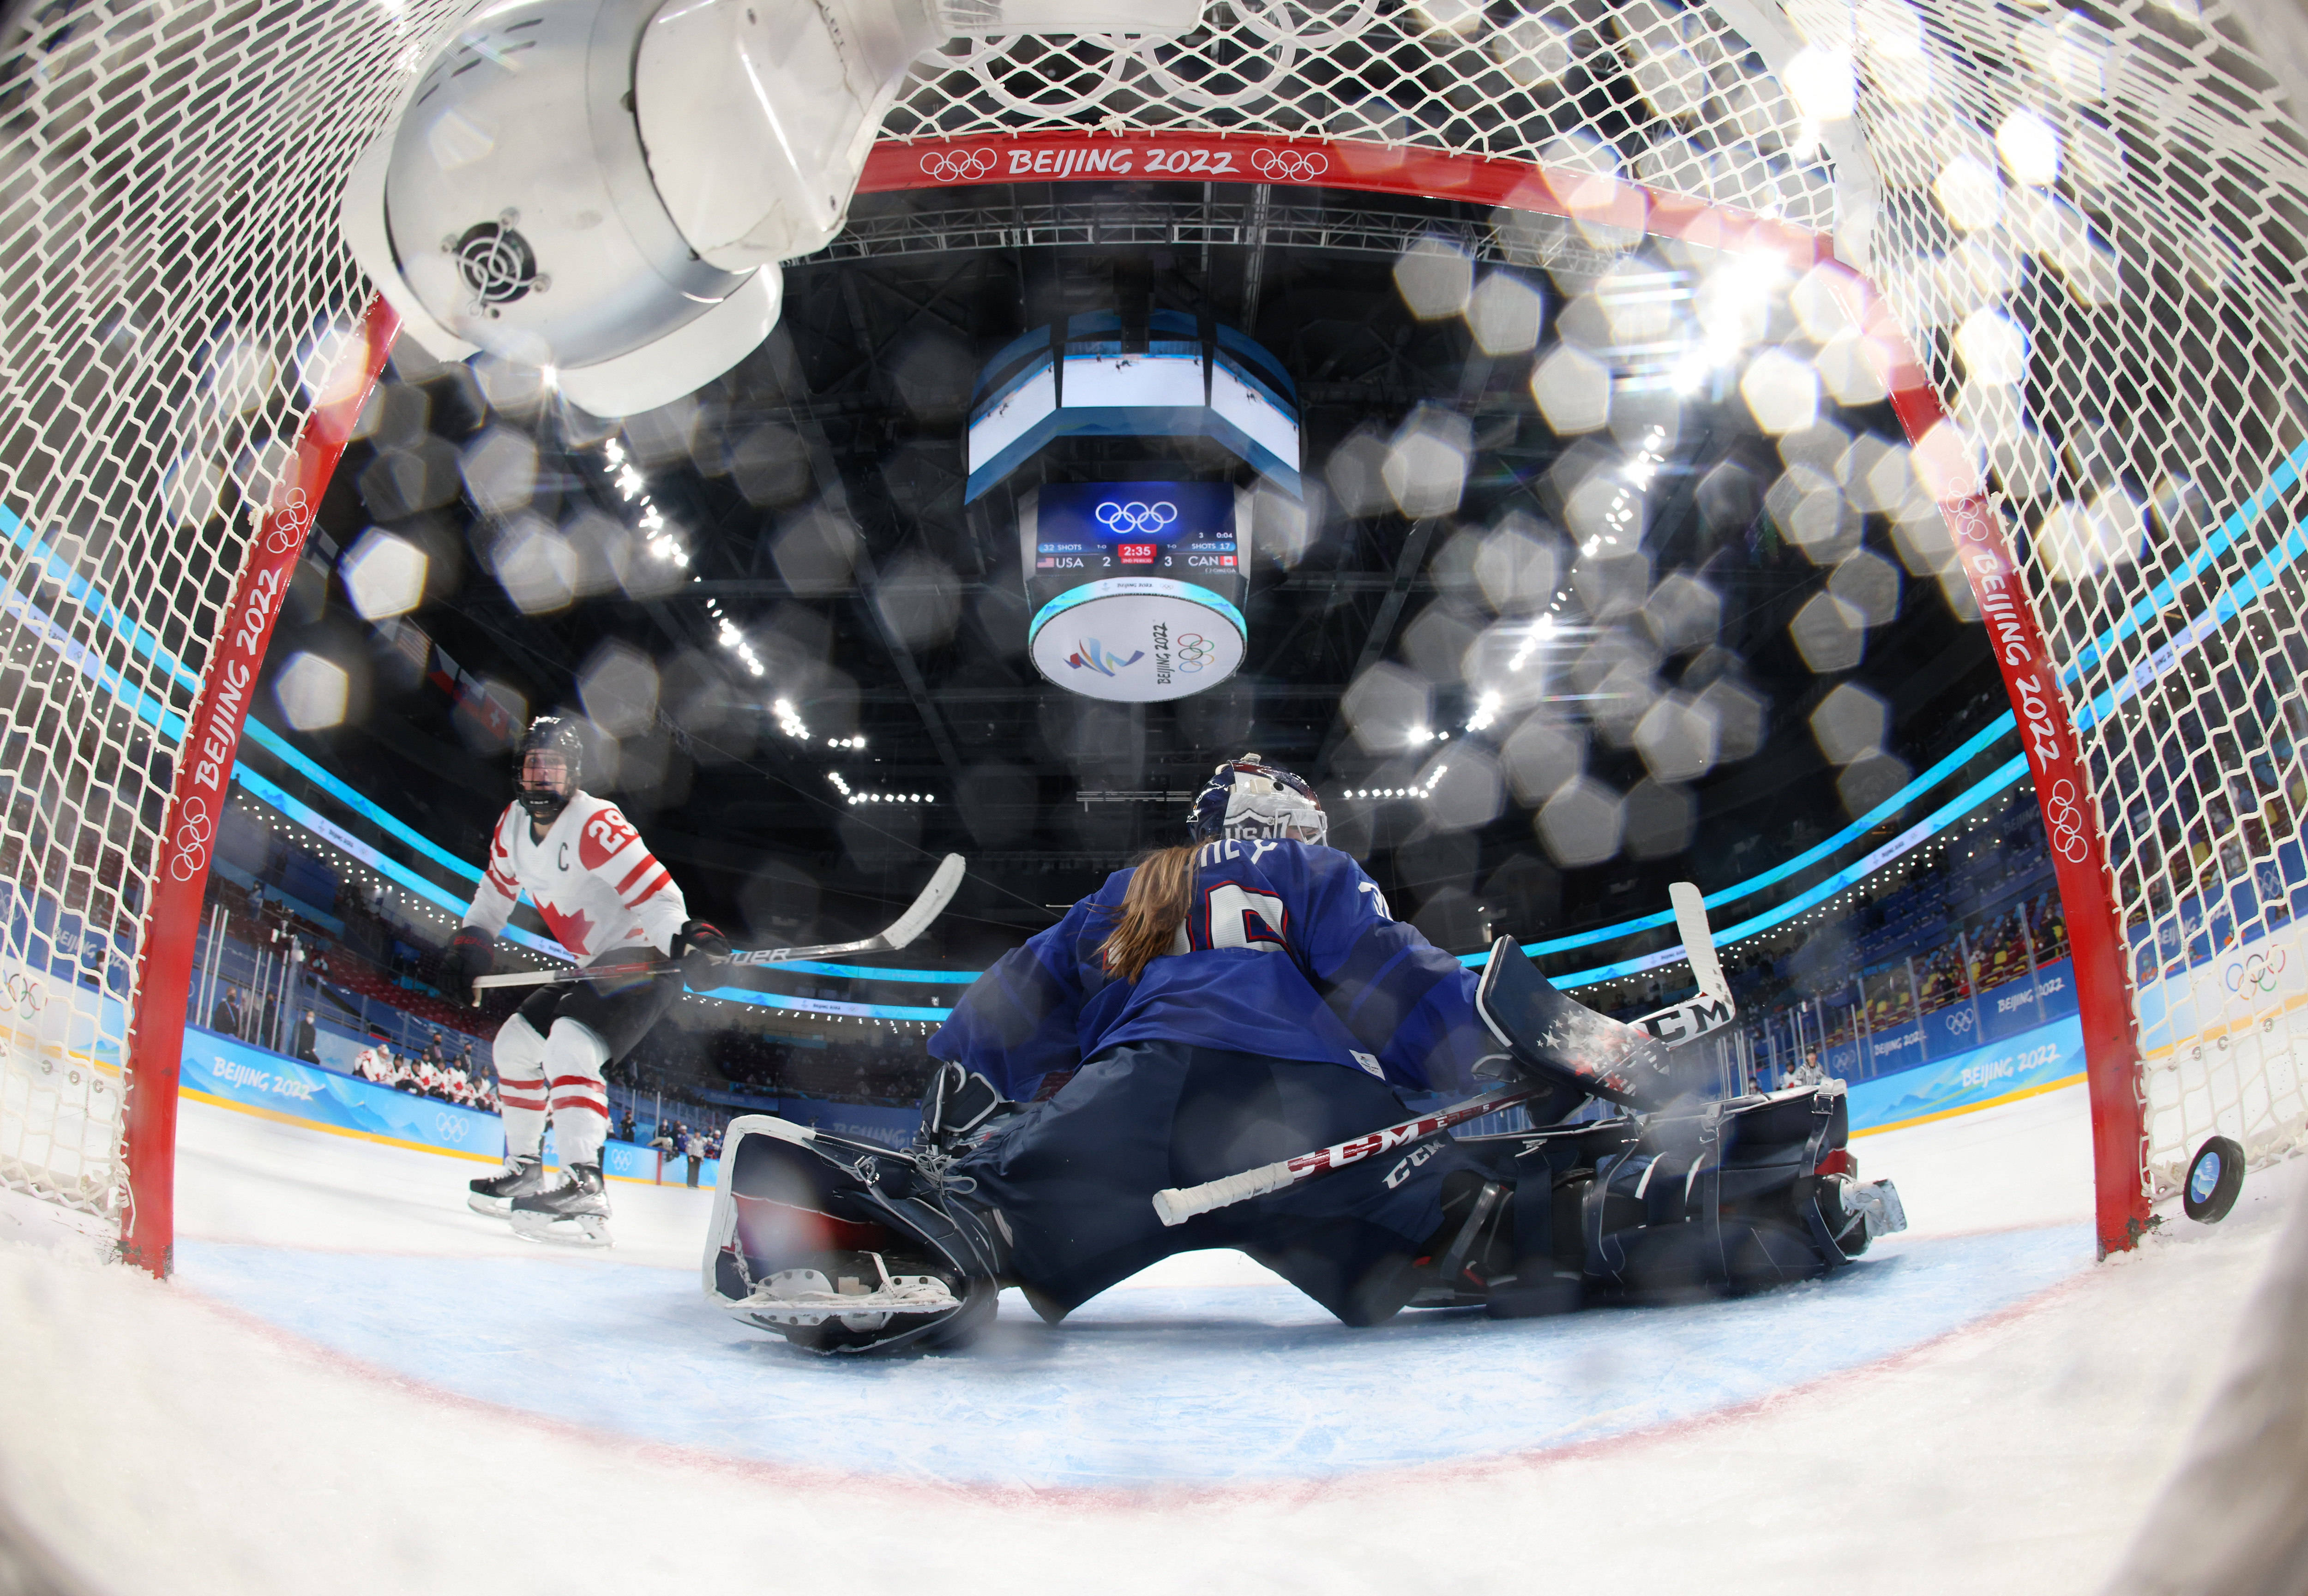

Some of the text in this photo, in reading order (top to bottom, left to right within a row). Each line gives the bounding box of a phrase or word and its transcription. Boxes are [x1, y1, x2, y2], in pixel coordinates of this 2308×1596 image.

[1008, 148, 1241, 178] BEIJING 2022
[1056, 557, 1111, 568] USA 2
[1124, 546, 1151, 556] 2:35
[1164, 556, 1219, 567] 3 CAN
[1154, 621, 1175, 685] BEIJING 2022
[1972, 549, 2032, 666] BEIJING
[2015, 674, 2060, 775] 2022
[195, 568, 282, 792] BEIJING 2022
[588, 810, 636, 854] 29
[558, 842, 569, 871] C
[1997, 977, 2066, 1013] BEIJING 2022
[1639, 999, 1730, 1044] CM
[1874, 1037, 1902, 1056] BEIJING
[1961, 1044, 2061, 1088] BEIJING 2022
[213, 1056, 313, 1100] BEIJING 2022
[1286, 1123, 1419, 1180] CCM
[1382, 1139, 1446, 1189] CCM
